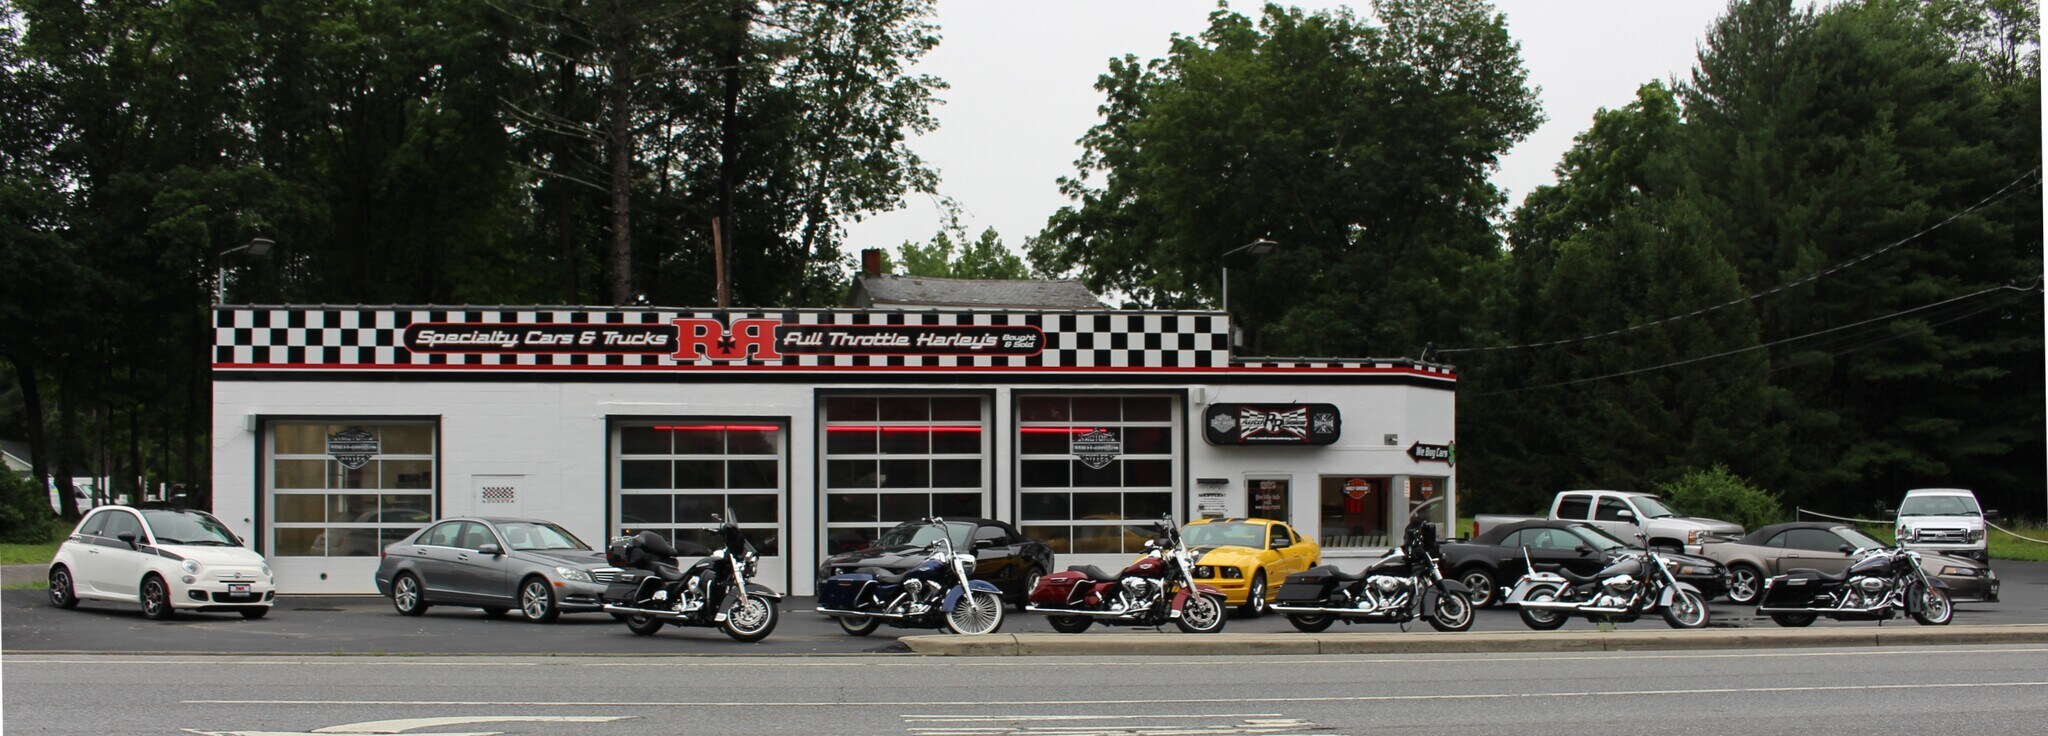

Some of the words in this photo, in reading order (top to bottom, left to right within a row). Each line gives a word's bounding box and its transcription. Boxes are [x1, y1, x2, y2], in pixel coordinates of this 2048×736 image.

[415, 330, 518, 348] Specialty
[524, 331, 573, 345] Cars
[579, 331, 596, 344] &
[602, 331, 668, 345] Trucks
[784, 332, 822, 347] Full
[828, 332, 910, 347] Throttle
[917, 333, 999, 349] Harley's
[1002, 334, 1036, 342] Bought
[1416, 446, 1425, 456] We
[1425, 447, 1435, 459] Buy
[1436, 448, 1448, 457] Cars
